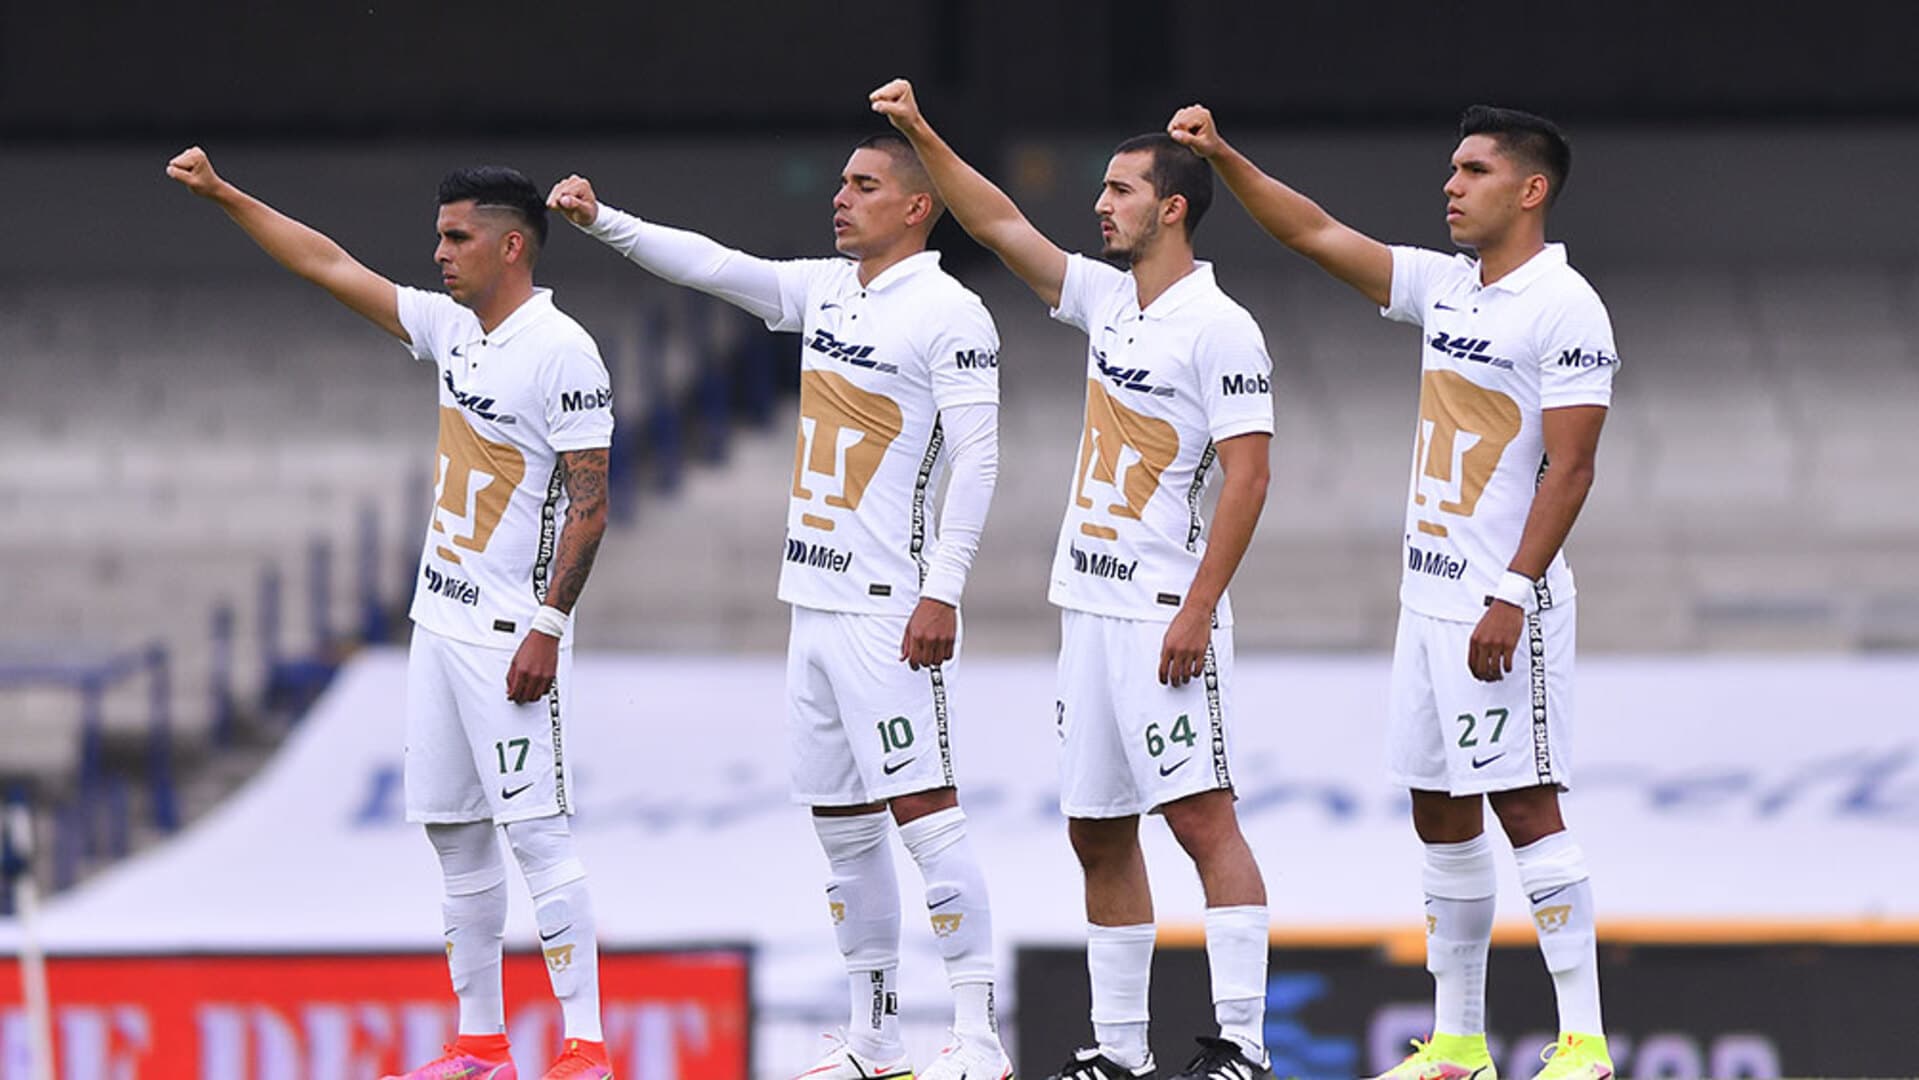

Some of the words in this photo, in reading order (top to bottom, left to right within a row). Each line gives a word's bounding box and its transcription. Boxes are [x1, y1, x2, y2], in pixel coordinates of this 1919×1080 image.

[956, 348, 999, 369] Mob
[1222, 373, 1268, 395] Mob
[808, 544, 852, 573] Mifel
[1090, 553, 1138, 581] Mifel
[1422, 551, 1467, 580] Mifel
[443, 576, 480, 606] Mifel
[1533, 656, 1545, 706] PUMAS
[877, 716, 914, 753] 10
[1145, 714, 1197, 757] 64
[1457, 708, 1509, 748] 27
[496, 738, 530, 774] 17
